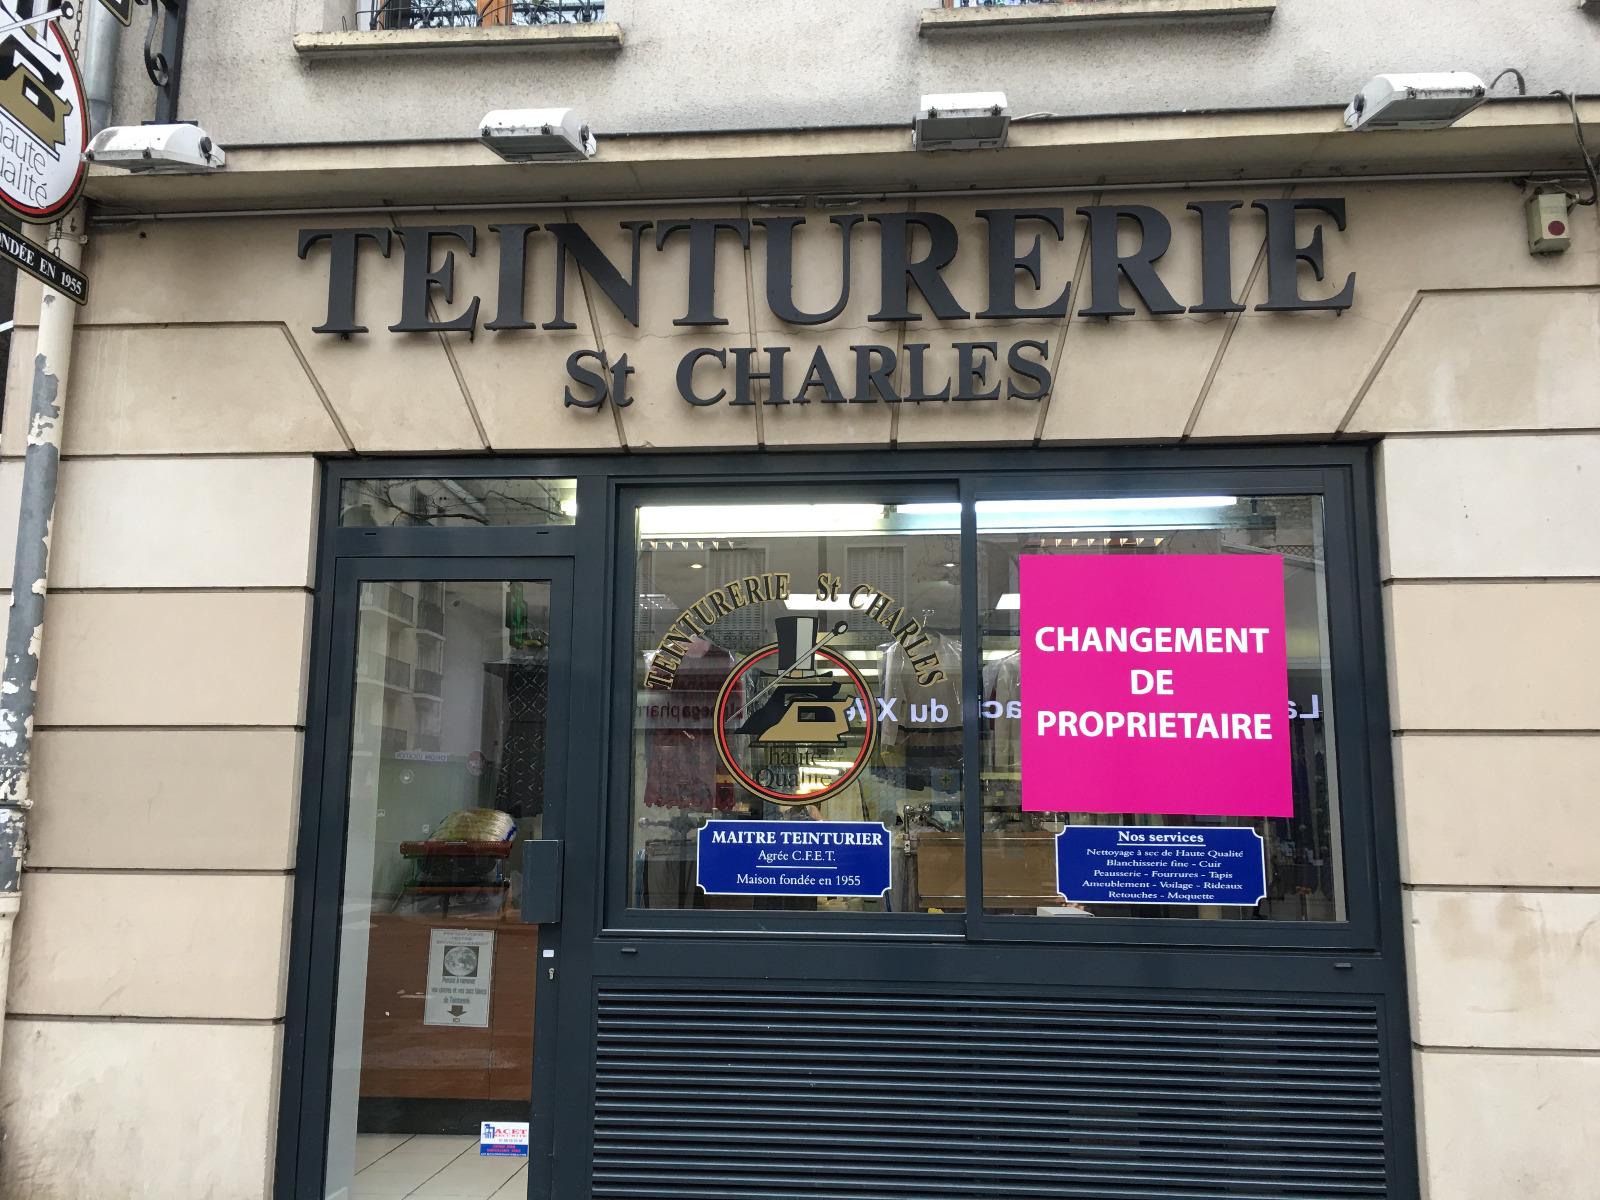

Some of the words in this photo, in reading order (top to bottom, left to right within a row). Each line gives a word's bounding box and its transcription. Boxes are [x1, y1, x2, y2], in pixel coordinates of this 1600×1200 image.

[0, 232, 35, 266] NDÉE
[40, 257, 56, 279] EN
[61, 271, 82, 294] 1955
[297, 197, 1356, 334] TEINTURERIE
[564, 349, 635, 408] St
[676, 339, 1052, 406] CHARLES
[644, 573, 790, 690] TEINTURERIE
[816, 572, 841, 602] St
[849, 583, 948, 687] CHARLES
[1035, 626, 1270, 654] CHANGEMENT
[1130, 669, 1174, 695] DE
[1037, 710, 1273, 740] PROPRIETAIRE
[711, 830, 777, 844] MAITRE
[780, 831, 884, 846] TEINTURIER
[1117, 830, 1145, 842] Nos
[1149, 832, 1205, 843] services
[757, 849, 789, 863] Agrée
[791, 850, 836, 862] C.F.E.T.
[1086, 848, 1135, 858] Nettoyage
[1161, 849, 1173, 857] de
[1175, 849, 1206, 857] Haute
[1207, 849, 1244, 859] Qualité
[1106, 859, 1168, 867] Blanchisserie
[1170, 859, 1189, 868] fine
[1198, 860, 1222, 868] Cuir
[736, 873, 777, 885] Maison
[779, 873, 816, 886] fondée
[818, 876, 832, 886] en
[835, 874, 861, 886] 1955
[1093, 869, 1142, 877] Peausserie
[1151, 870, 1199, 878] Fourrures
[1208, 870, 1233, 881] Tapis
[1081, 879, 1150, 888] Ameublement
[1159, 881, 1194, 891] Voilage
[1203, 881, 1243, 890] Rideaux
[1108, 890, 1158, 899] Retouches
[1167, 891, 1215, 901] Moquette
